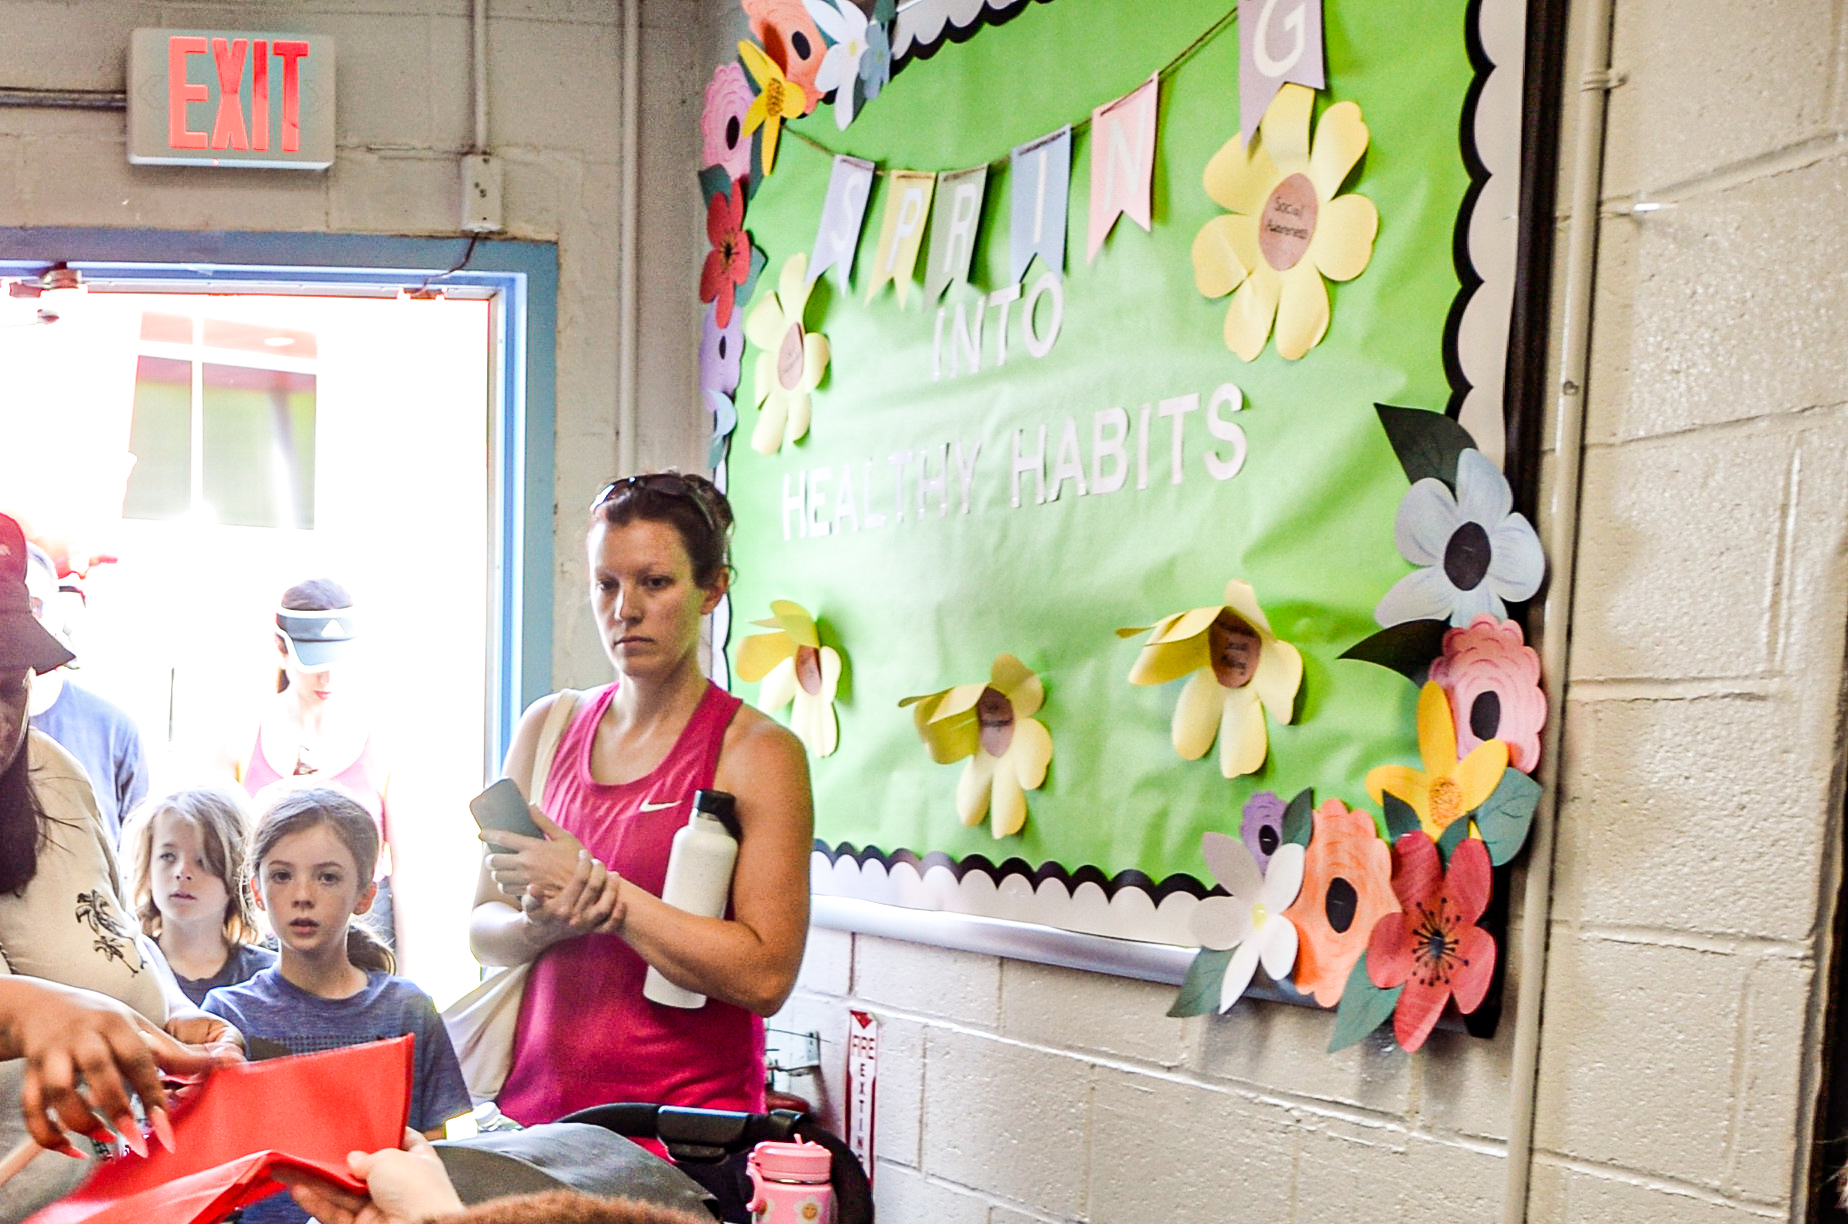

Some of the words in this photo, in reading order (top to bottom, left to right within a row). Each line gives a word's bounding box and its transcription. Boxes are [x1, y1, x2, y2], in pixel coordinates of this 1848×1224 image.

[168, 34, 311, 153] EXIT
[1273, 196, 1304, 218] Social
[932, 270, 1066, 382] INTO
[781, 438, 982, 541] HEALTHY
[1010, 382, 1249, 509] HABITS
[851, 1034, 876, 1061] FIRE
